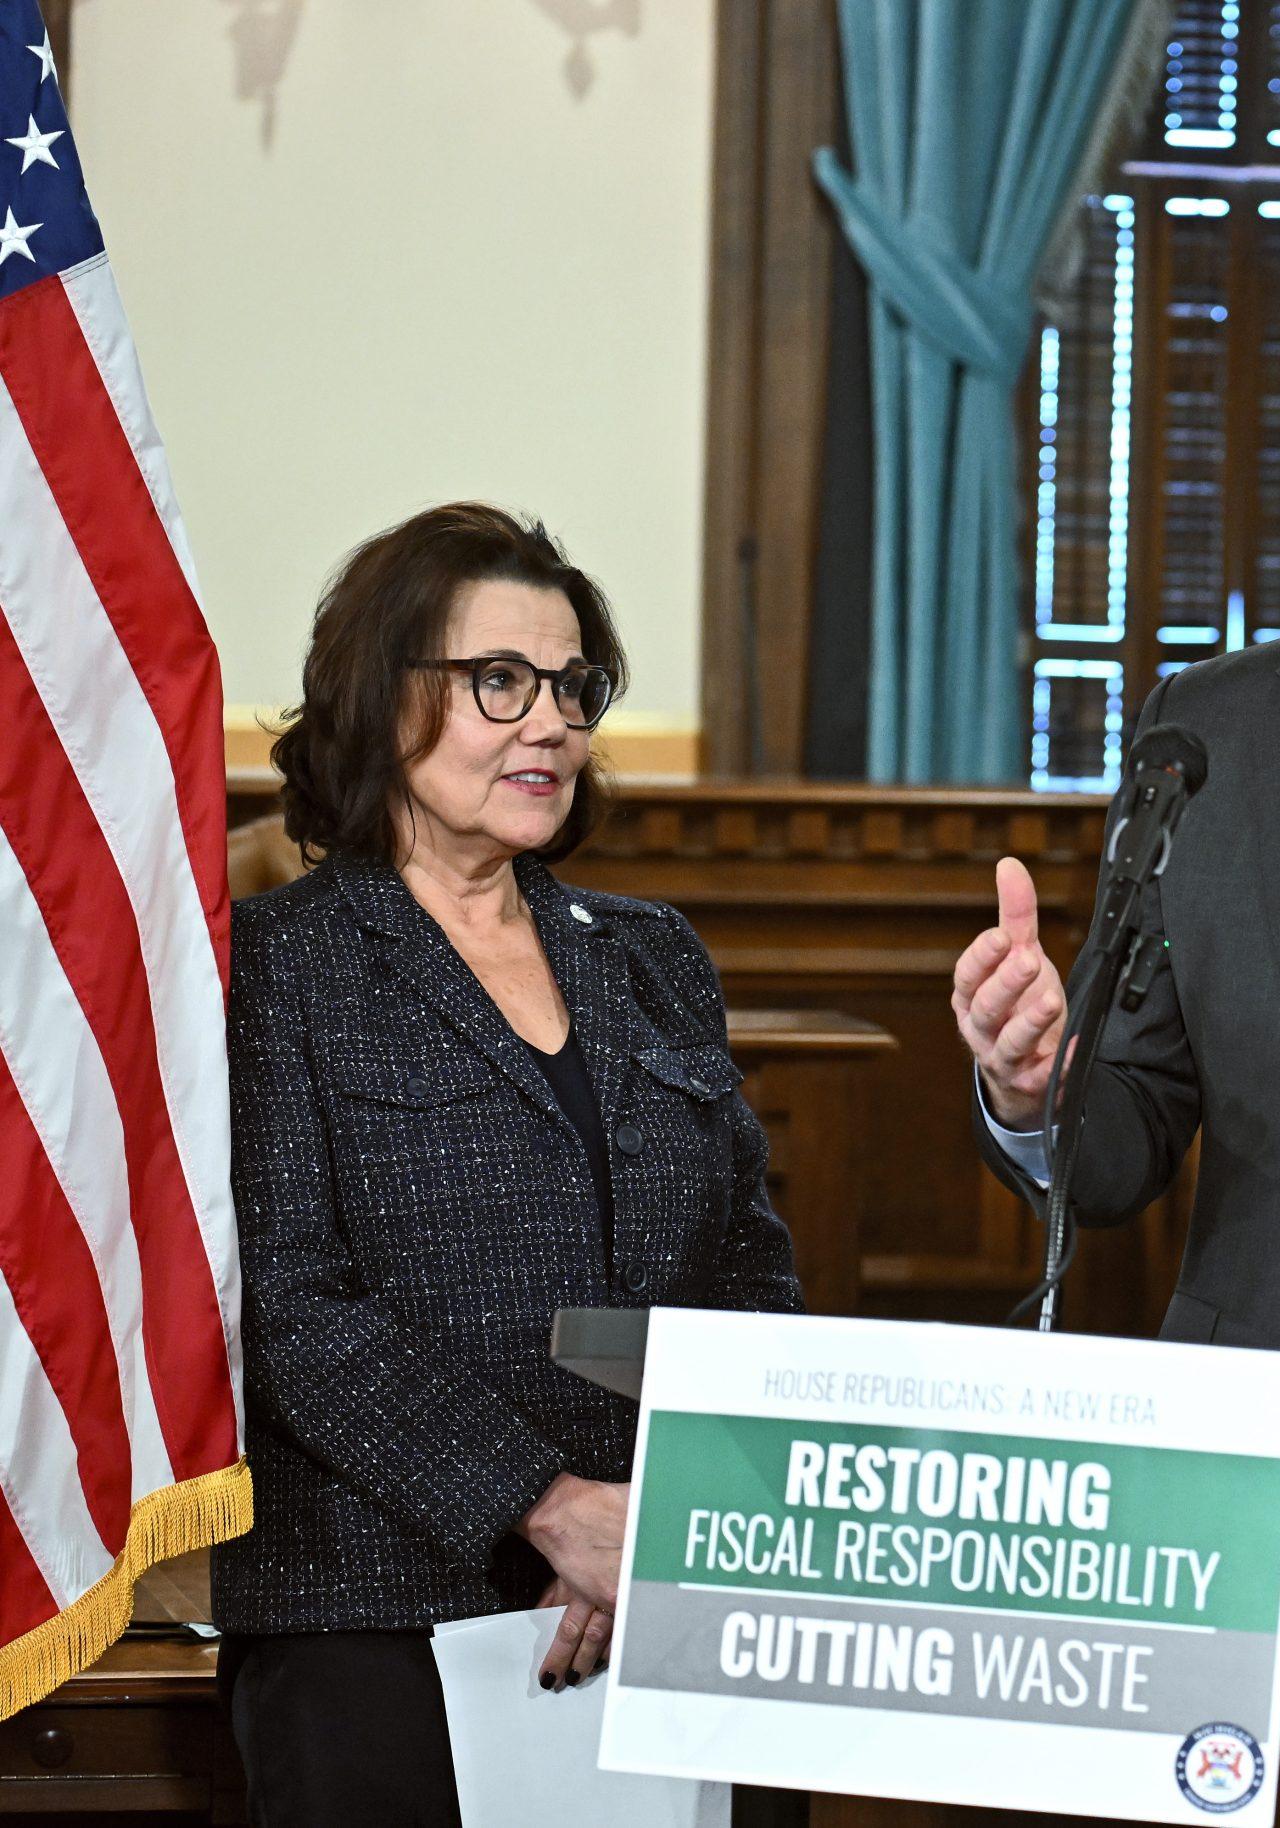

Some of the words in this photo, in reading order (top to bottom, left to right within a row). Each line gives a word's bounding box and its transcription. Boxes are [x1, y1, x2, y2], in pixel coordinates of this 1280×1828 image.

[763, 1369, 837, 1403] HOUSE
[1018, 1387, 1036, 1415] A
[1042, 1389, 1099, 1421] NEW
[1108, 1394, 1157, 1425] ERA
[786, 1441, 1111, 1530] RESTORING
[685, 1510, 821, 1578] FISCAL
[835, 1521, 1220, 1611] RESPONSIBILITY
[719, 1611, 955, 1696] CUTTING
[972, 1631, 1155, 1714] WASTE
